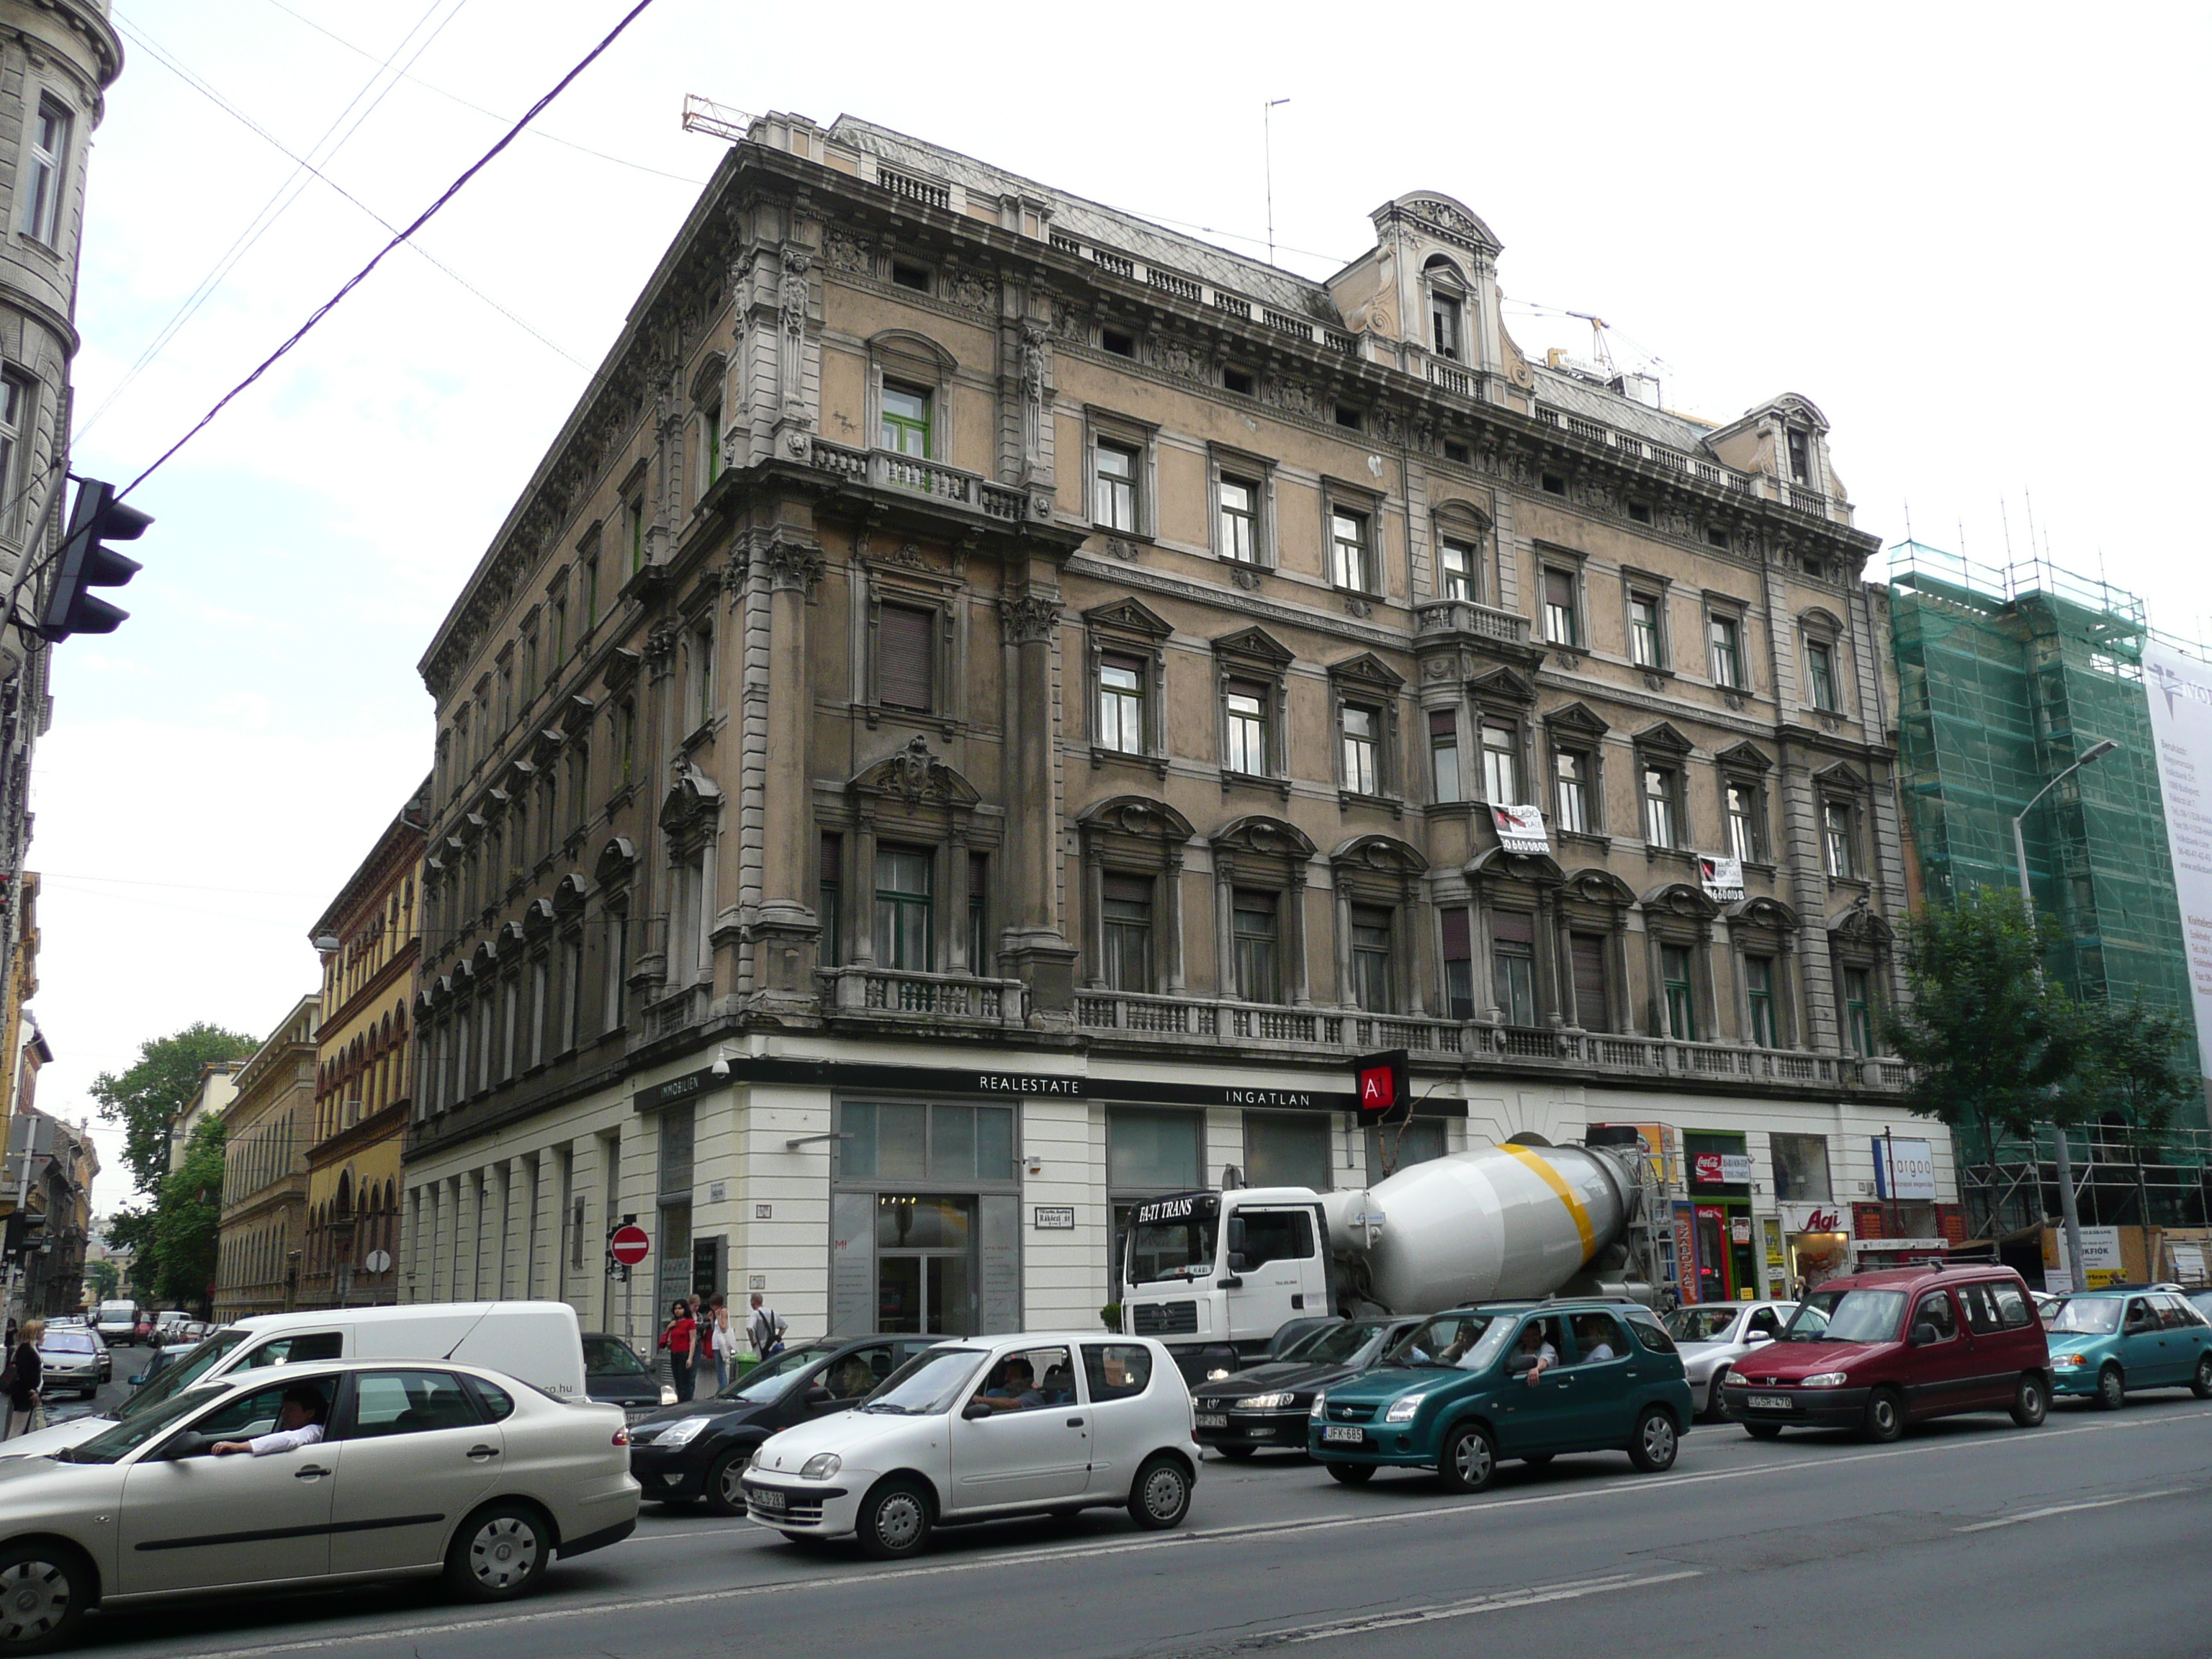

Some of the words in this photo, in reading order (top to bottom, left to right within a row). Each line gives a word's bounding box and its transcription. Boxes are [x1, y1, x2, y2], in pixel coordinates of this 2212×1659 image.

[660, 1076, 698, 1099] IMMOBILIEN
[980, 1076, 1079, 1094] REALESTATE
[1364, 1077, 1385, 1100] A1
[1226, 1090, 1310, 1107] INGATLAN
[1161, 1197, 1193, 1219] TRANS
